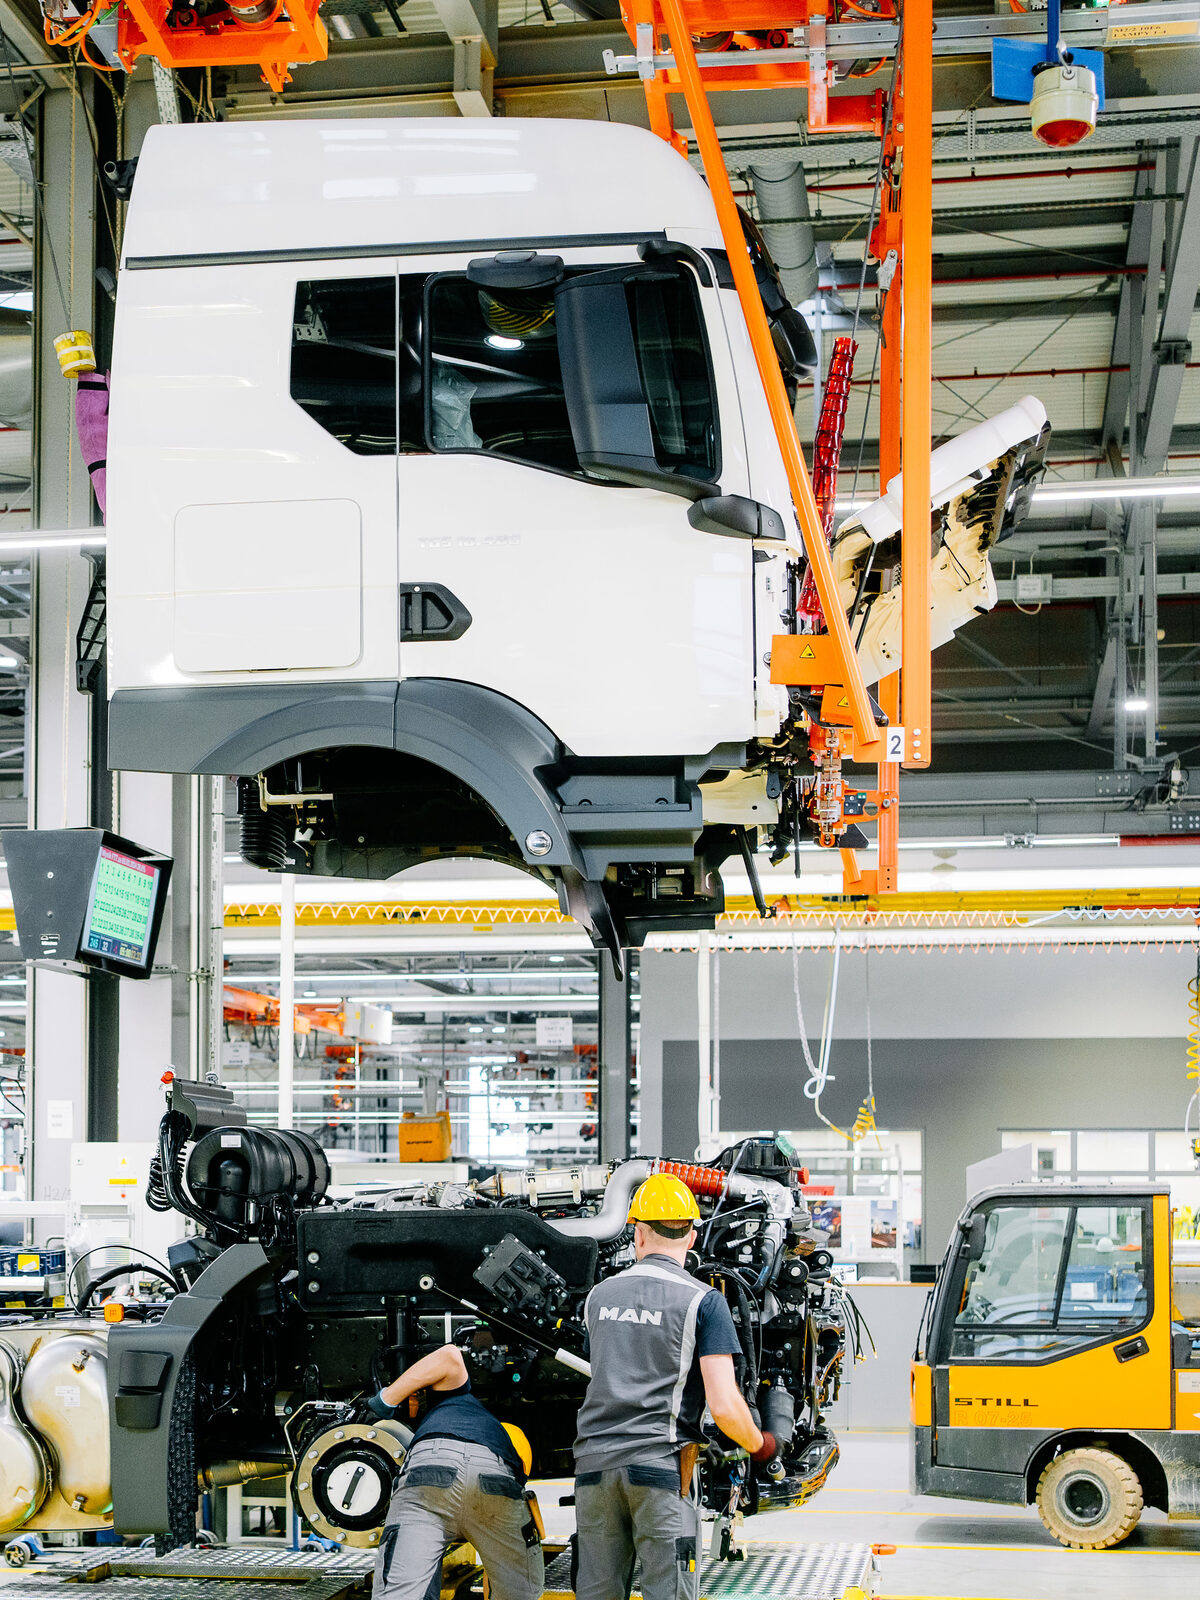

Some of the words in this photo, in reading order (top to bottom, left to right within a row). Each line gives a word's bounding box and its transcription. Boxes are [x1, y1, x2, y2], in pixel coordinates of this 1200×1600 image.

[890, 735, 901, 754] 2
[599, 1306, 663, 1326] MAN
[954, 1397, 1039, 1407] STILL
[954, 1411, 968, 1426] R
[974, 1411, 1033, 1426] 07-25
